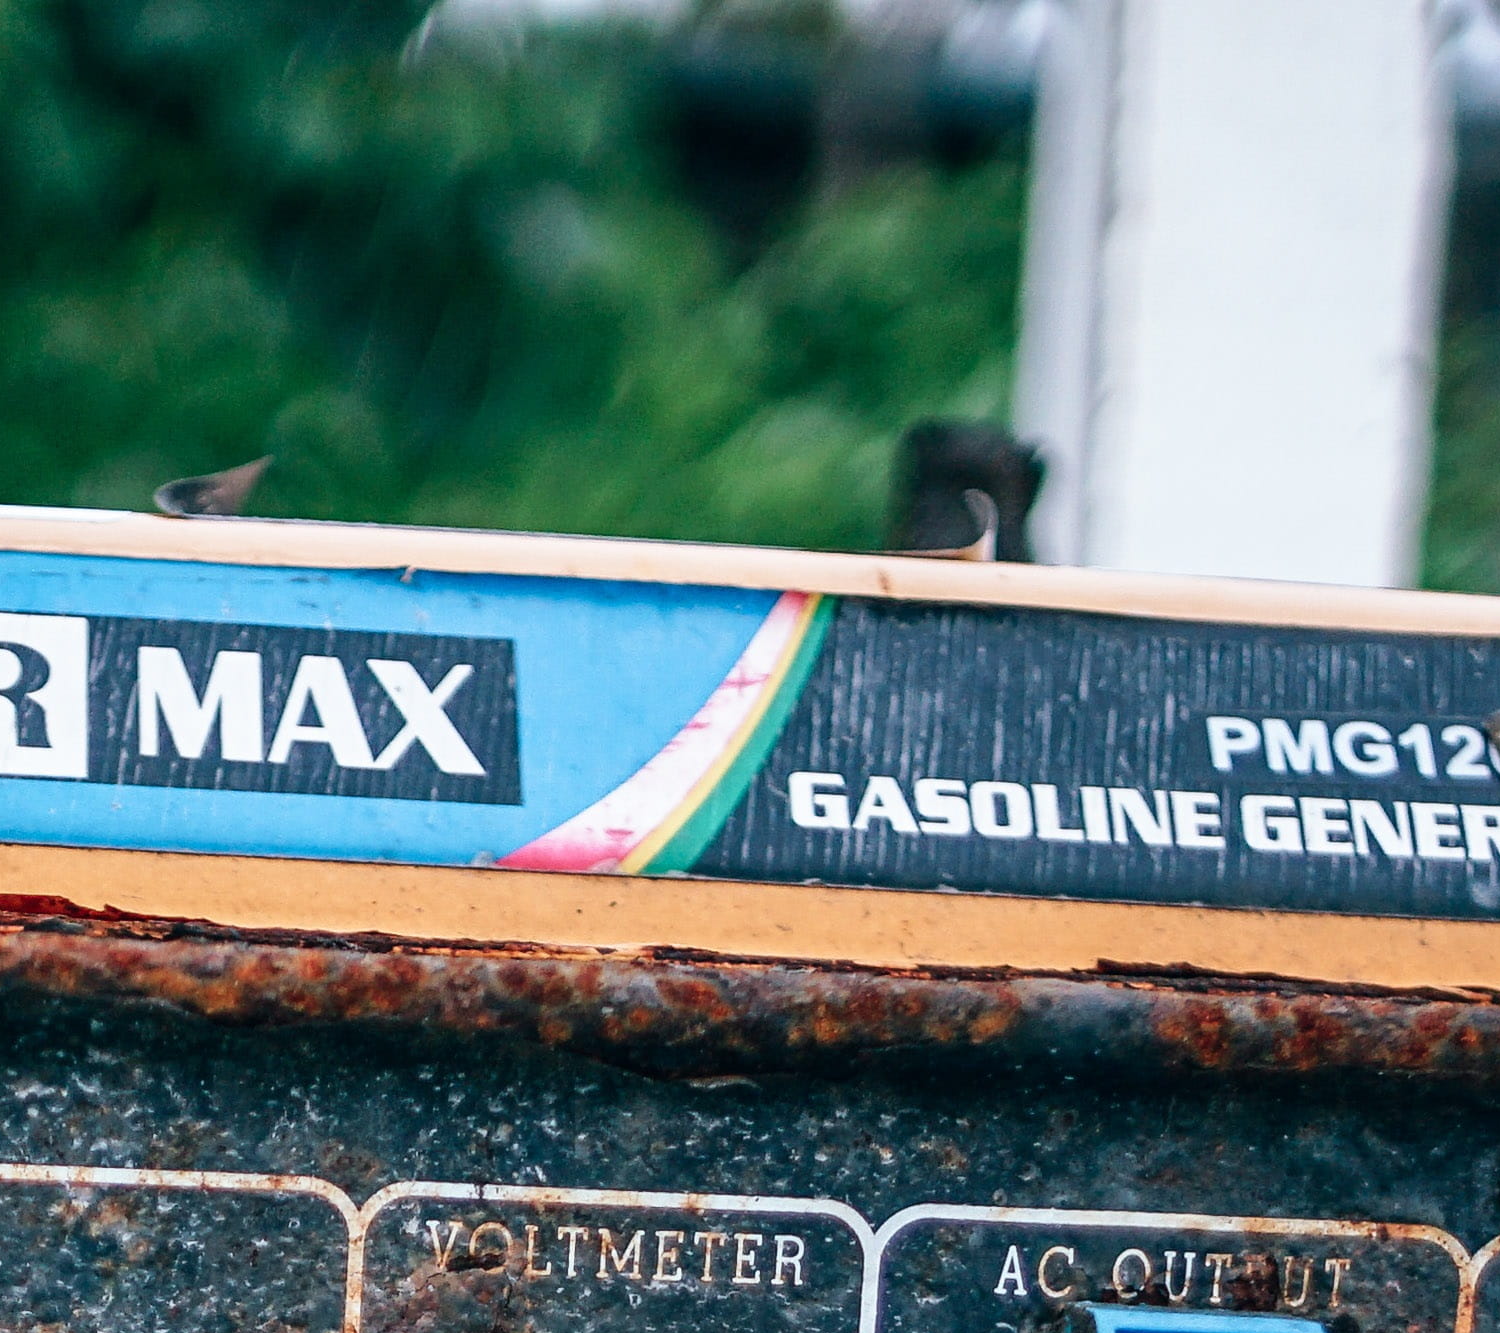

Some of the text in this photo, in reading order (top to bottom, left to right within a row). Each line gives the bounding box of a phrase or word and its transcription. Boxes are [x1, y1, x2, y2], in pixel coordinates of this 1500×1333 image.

[138, 646, 487, 776] MAX
[788, 772, 1227, 849] GASOLINE
[425, 1219, 805, 1286] VOLTMETER
[994, 1244, 1352, 1308] AC OUTUT
